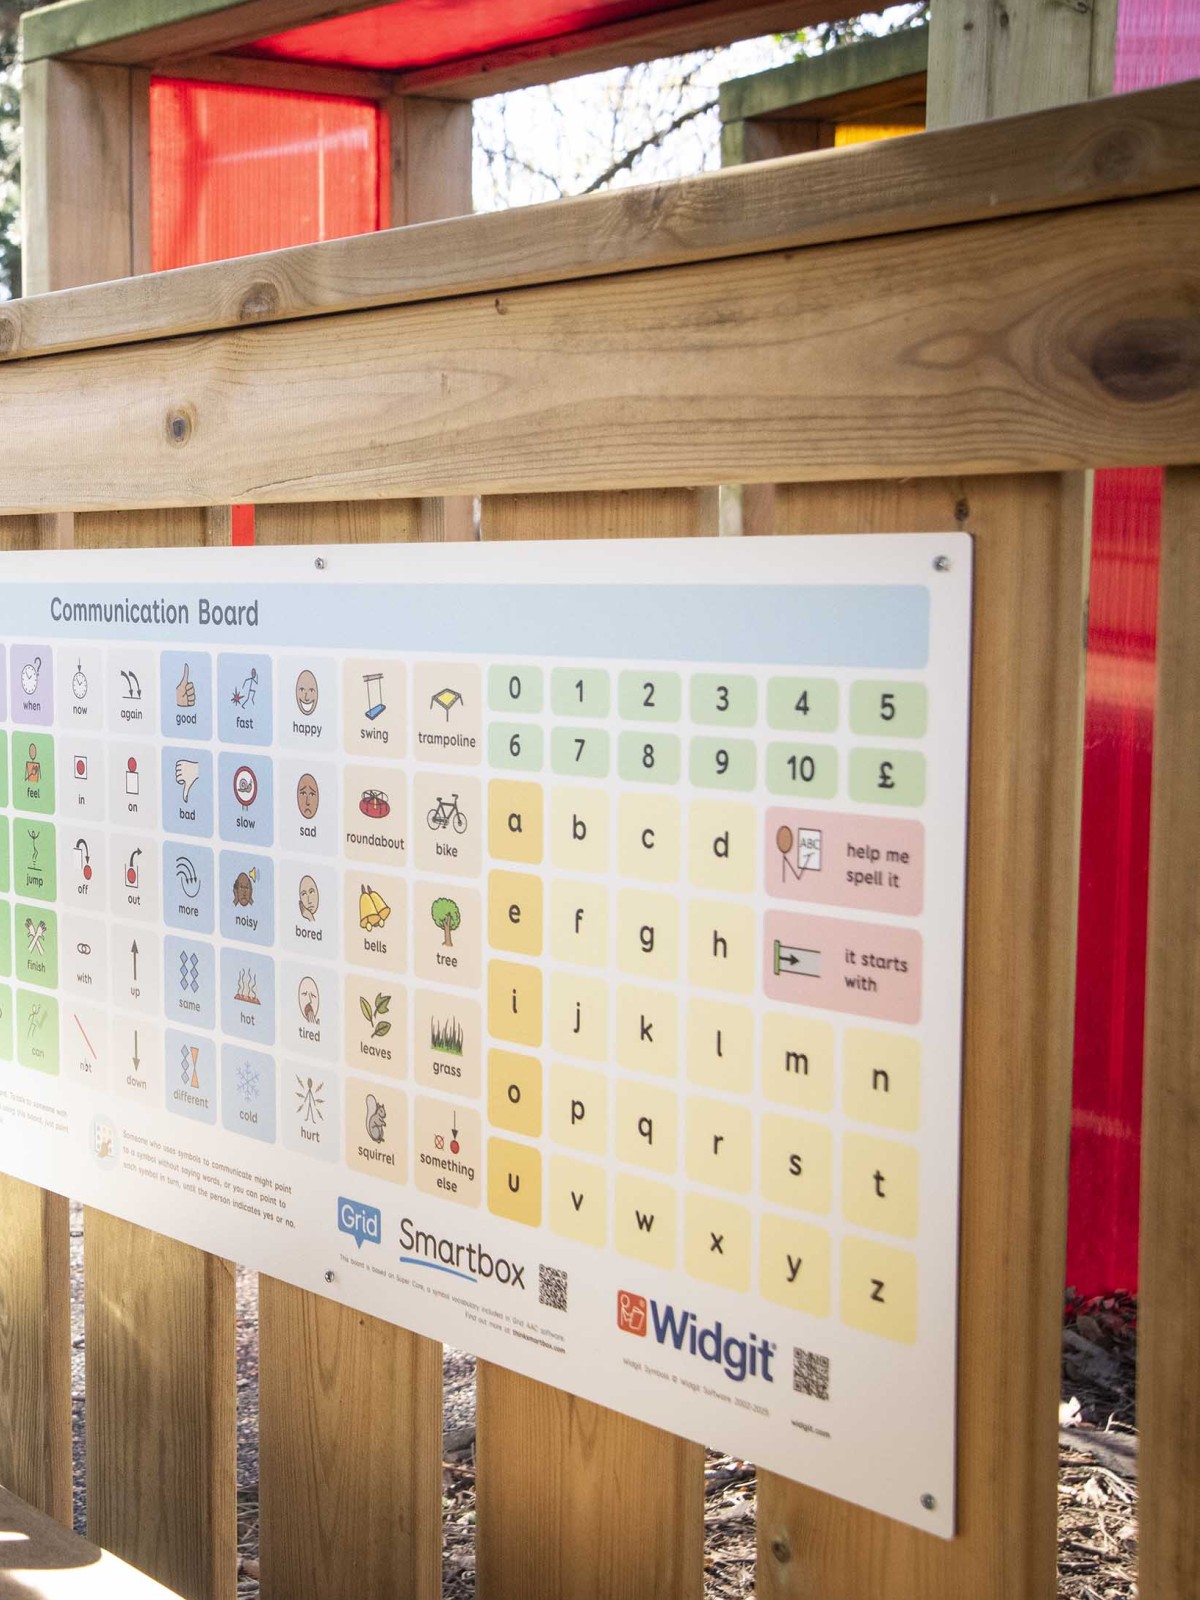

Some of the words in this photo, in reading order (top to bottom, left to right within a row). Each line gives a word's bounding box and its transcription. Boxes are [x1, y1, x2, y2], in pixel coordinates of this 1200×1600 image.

[50, 597, 189, 624] Communication
[199, 598, 258, 627] Board
[509, 676, 521, 699] 0
[575, 679, 583, 703] 1
[643, 682, 655, 707] 2
[23, 700, 41, 711] when
[716, 686, 729, 712] 3
[795, 690, 810, 715] 4
[880, 693, 895, 721] 5
[73, 706, 88, 715] now
[120, 708, 143, 722] again
[175, 713, 197, 726] good
[236, 716, 254, 729] fast
[293, 721, 322, 738] happy
[360, 727, 389, 744] swing
[418, 731, 476, 748] trampoline
[509, 733, 521, 757] 6
[574, 738, 586, 762] 7
[642, 743, 655, 769] 8
[715, 749, 729, 775] 9
[787, 755, 815, 782] 10
[878, 761, 895, 789] £
[27, 787, 40, 799] feel
[78, 794, 85, 805] in
[127, 803, 138, 812] on
[179, 807, 196, 821] bad
[236, 816, 256, 829] slow
[299, 826, 317, 838] sad
[508, 813, 522, 833] a
[573, 814, 587, 841] b
[346, 833, 405, 850] roundabout
[641, 828, 655, 849] c
[713, 831, 729, 858] d
[436, 843, 458, 858] bike
[847, 843, 881, 863] help
[886, 850, 910, 864] me
[26, 873, 44, 888] jump
[846, 870, 883, 886] spell
[888, 872, 899, 888] it
[77, 884, 89, 895] off
[127, 895, 141, 906] out
[178, 905, 199, 917] more
[508, 904, 521, 924] e
[575, 908, 584, 934] f
[235, 915, 258, 931] noisy
[295, 925, 322, 941] bored
[364, 938, 387, 954] bells
[640, 925, 654, 953] g
[713, 930, 727, 958] h
[27, 959, 46, 973] finish
[436, 952, 458, 968] tree
[845, 951, 856, 965] it
[861, 954, 908, 973] starts
[76, 972, 92, 984] with
[844, 975, 877, 991] with
[130, 987, 141, 999] up
[512, 988, 518, 1014] i
[179, 999, 201, 1012] same
[240, 1011, 255, 1026] hot
[573, 1002, 580, 1034] j
[298, 1027, 320, 1042] tired
[640, 1015, 653, 1042] k
[31, 1047, 45, 1059] can
[360, 1041, 392, 1060] leaves
[432, 1062, 462, 1078] grass
[786, 1051, 808, 1075] m
[126, 1075, 147, 1090] down
[873, 1069, 889, 1092] n
[173, 1089, 209, 1109] different
[507, 1084, 521, 1104] o
[239, 1110, 258, 1124] cold
[571, 1099, 585, 1125] p
[300, 1126, 320, 1143] hurt
[638, 1117, 653, 1145] q
[714, 1135, 724, 1155] r
[358, 1146, 395, 1166] squirrel
[789, 1154, 802, 1176] s
[420, 1153, 475, 1181] something
[436, 1177, 458, 1193] else
[508, 1173, 520, 1193] u
[873, 1170, 885, 1198] t
[209, 1192, 231, 1206] person
[233, 1198, 261, 1217] indicates
[262, 1211, 274, 1221] yes
[275, 1215, 283, 1224] or
[285, 1219, 296, 1229] no.
[571, 1191, 584, 1211] v
[340, 1204, 379, 1238] Grid
[635, 1210, 654, 1233] w
[710, 1232, 724, 1254] x
[399, 1218, 525, 1290] Smartbox
[787, 1255, 802, 1283] y
[871, 1279, 885, 1303] z
